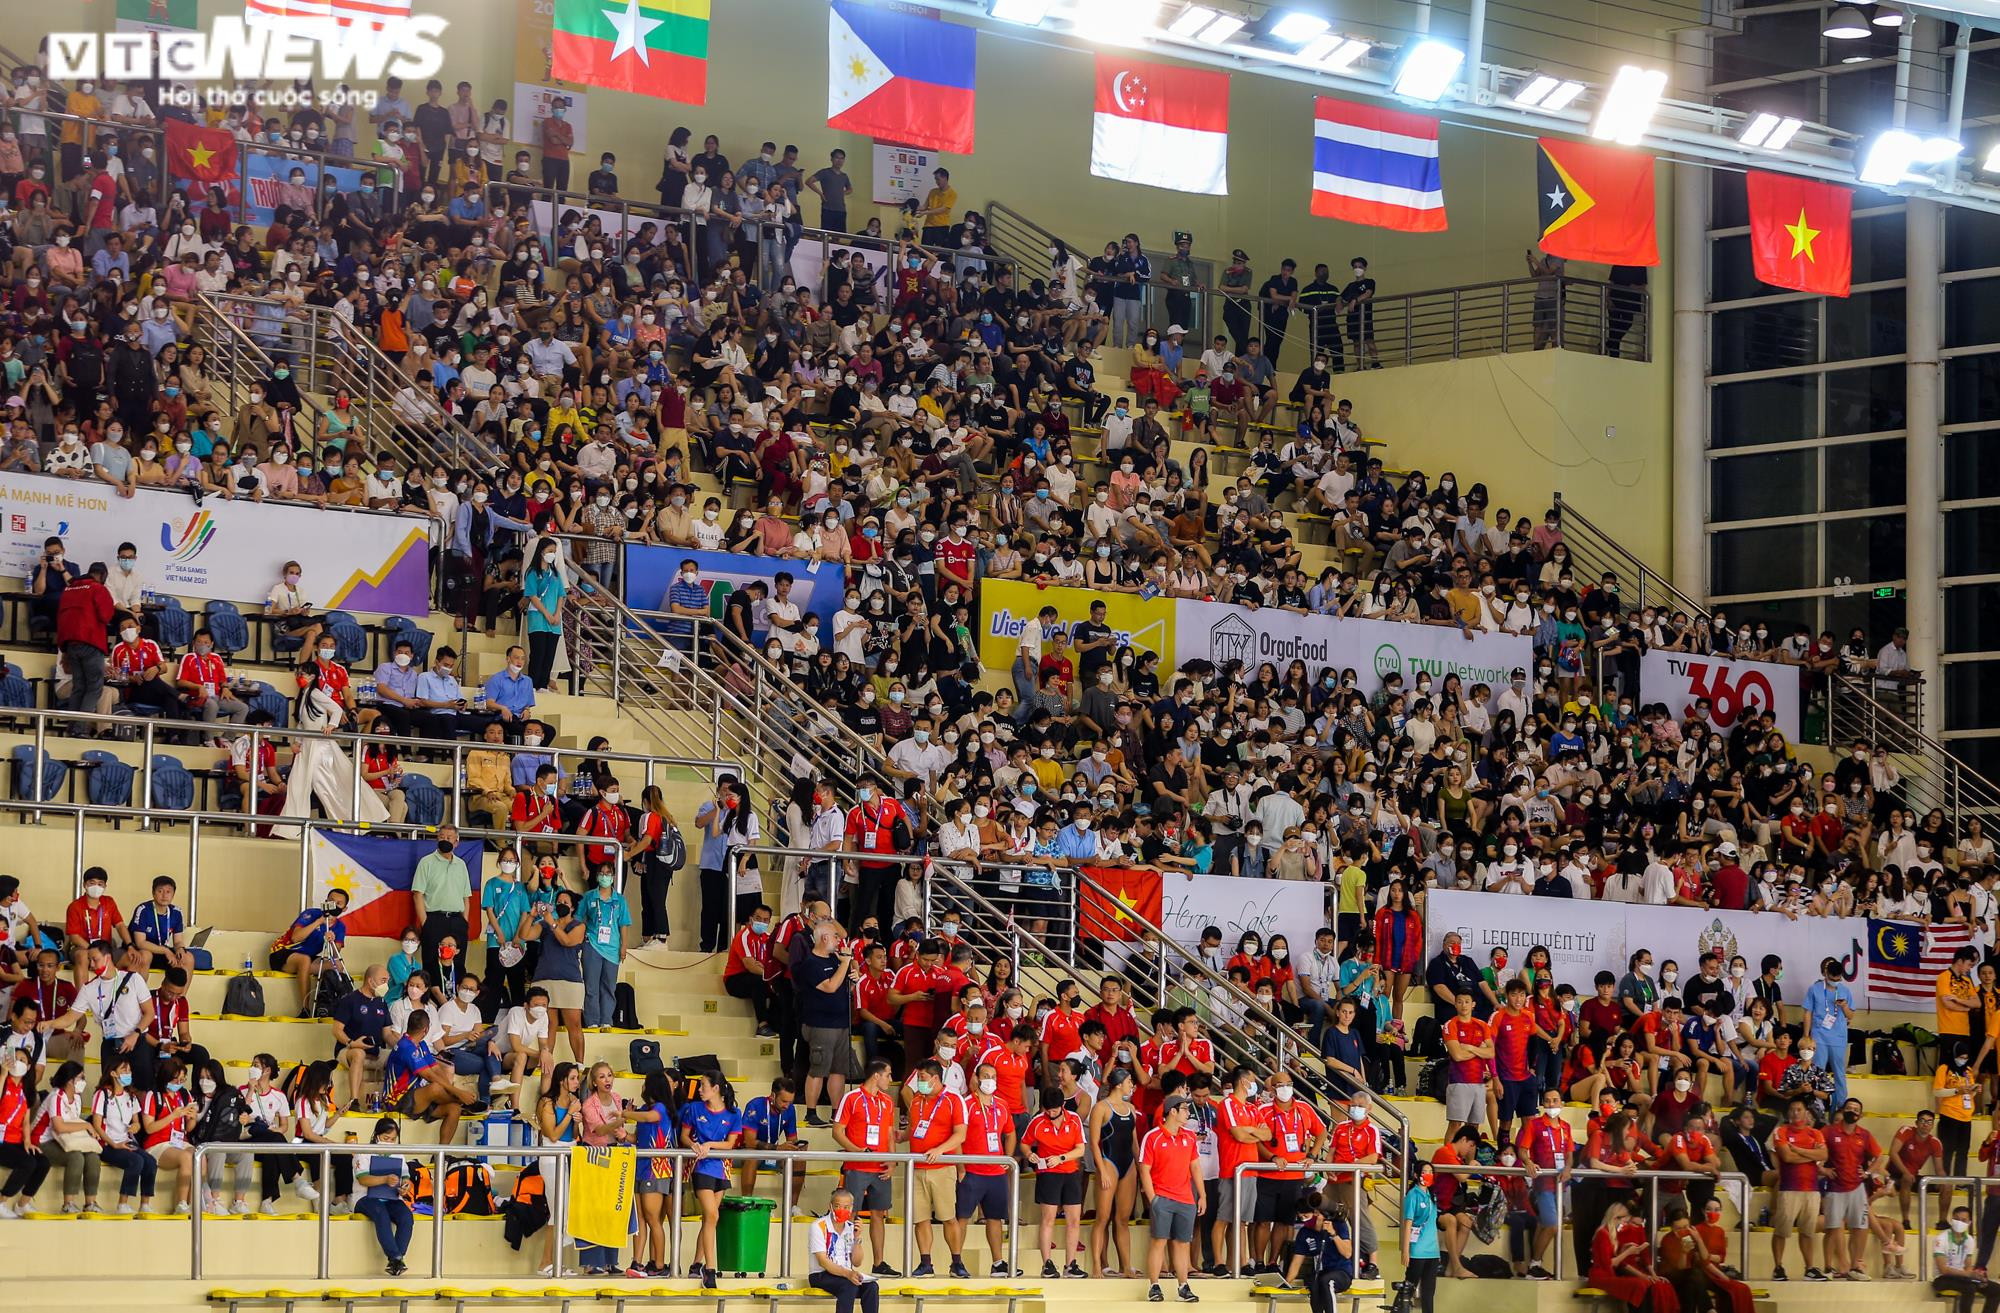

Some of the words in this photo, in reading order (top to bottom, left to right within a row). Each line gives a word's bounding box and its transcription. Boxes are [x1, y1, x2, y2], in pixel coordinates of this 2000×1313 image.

[12, 489, 51, 504] MẠNH
[78, 498, 107, 512] HƠN
[179, 575, 193, 583] NAM
[194, 577, 208, 585] 2021
[1260, 632, 1328, 662] OrgaFood
[1378, 656, 1398, 669] TVU
[1408, 657, 1442, 677] TVU
[1448, 661, 1510, 684] Network
[1228, 887, 1287, 938] Lake
[616, 1161, 629, 1211] SWIMMING
